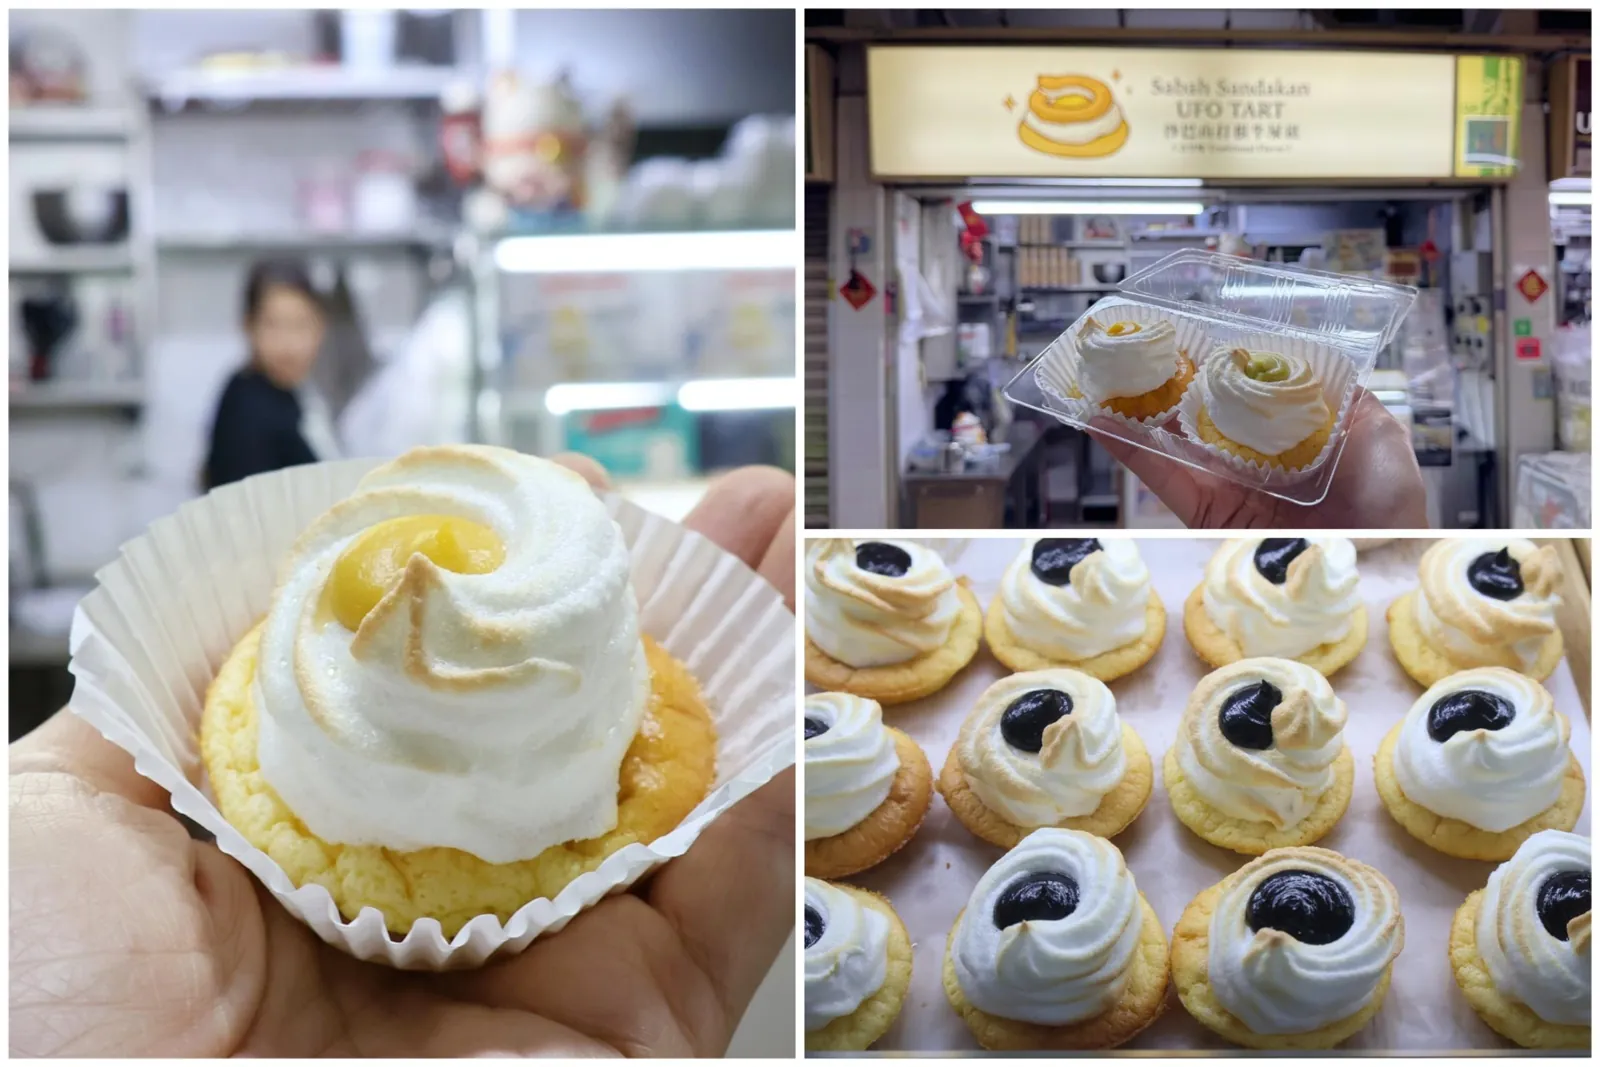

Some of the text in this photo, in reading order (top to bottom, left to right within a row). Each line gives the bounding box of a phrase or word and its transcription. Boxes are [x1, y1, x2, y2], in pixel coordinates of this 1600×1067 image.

[1150, 76, 1211, 97] Sabah
[1176, 101, 1286, 119] UFO TART
